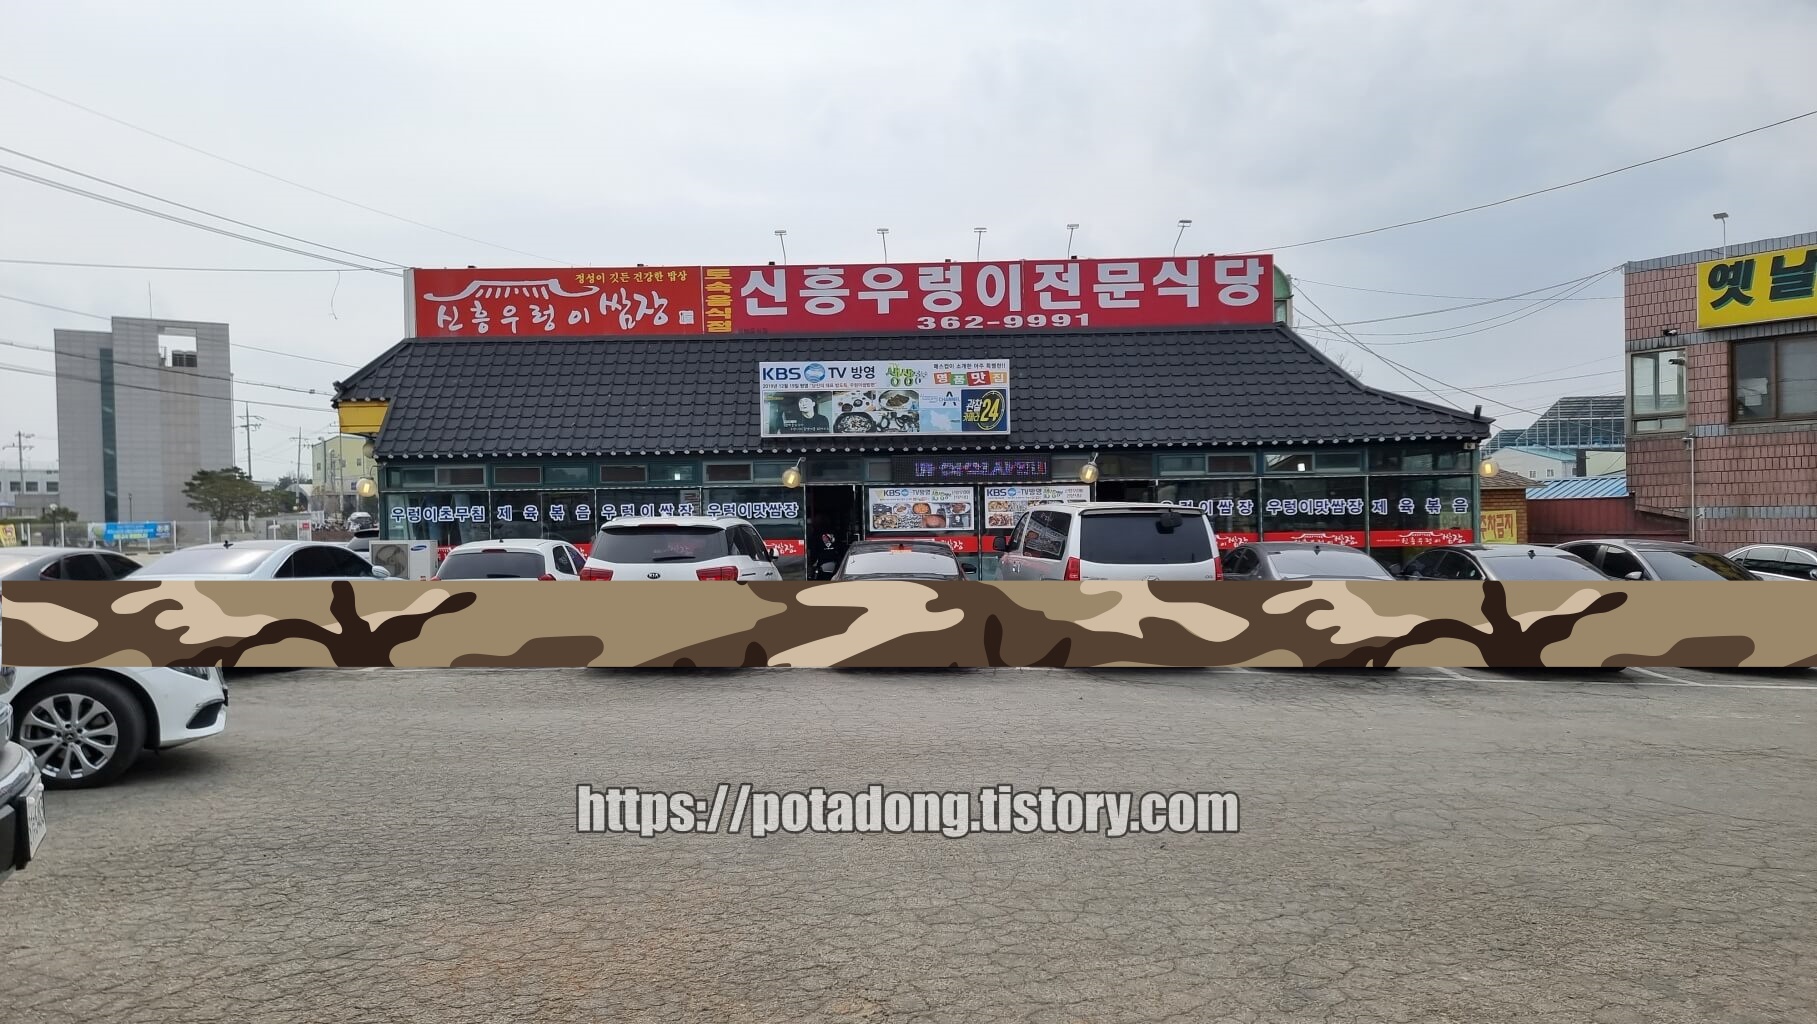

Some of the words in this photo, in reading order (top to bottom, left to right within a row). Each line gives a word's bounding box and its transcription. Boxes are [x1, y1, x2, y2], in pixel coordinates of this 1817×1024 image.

[575, 272, 605, 284] 정성이
[633, 271, 664, 283] 건강한
[667, 270, 688, 282] 밥상
[1708, 250, 1817, 311] 옛날
[739, 258, 1265, 317] 신흥우렁이전문식당
[704, 268, 733, 333] 토속음식점
[437, 300, 590, 334] 신흥우렁이
[599, 287, 669, 330] 쌈장
[916, 313, 1089, 330] 362-9991
[762, 367, 802, 381] KBS
[828, 367, 847, 379] TV
[851, 365, 876, 380] 방영
[980, 398, 1000, 422] 24
[883, 488, 901, 497] KBS
[986, 488, 1007, 497] KBS
[390, 505, 486, 522] 우렁이초무침
[497, 504, 592, 521] 제육볶음
[707, 501, 799, 518] 우렁이맛쌈장
[1266, 498, 1364, 515] 우렁이맛쌈장
[1371, 497, 1468, 514] 제육볶음
